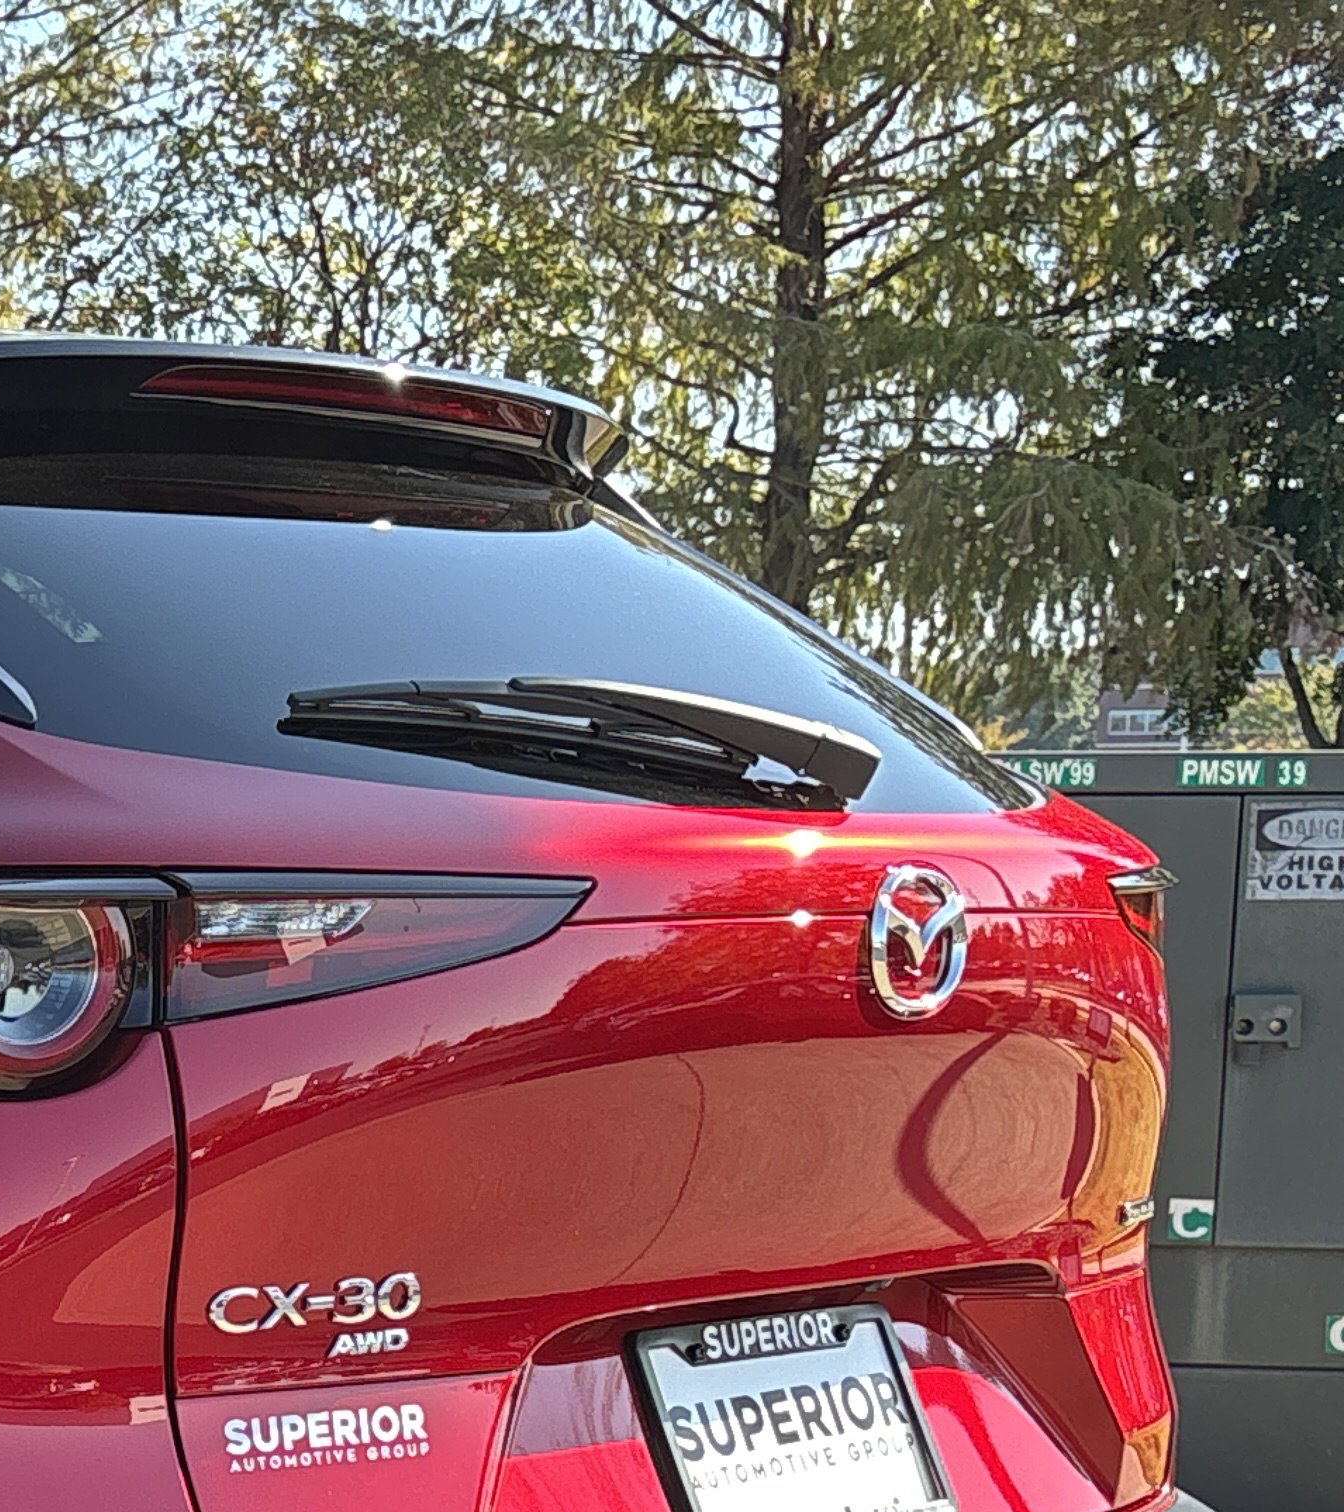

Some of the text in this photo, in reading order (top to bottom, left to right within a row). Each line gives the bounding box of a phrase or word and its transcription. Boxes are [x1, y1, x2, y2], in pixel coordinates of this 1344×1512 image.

[1181, 760, 1307, 785] PMSW 39
[1278, 818, 1344, 840] DANG
[208, 1272, 422, 1334] CX-30
[326, 1328, 410, 1358] AWD
[701, 1311, 835, 1360] SUPERIOR
[223, 1403, 428, 1455] SUPERIOR
[667, 1372, 910, 1462] SUPERIOR
[229, 1441, 430, 1474] AUTOMOTIVE GROUP
[691, 1446, 836, 1490] AUTOMOTIVE
